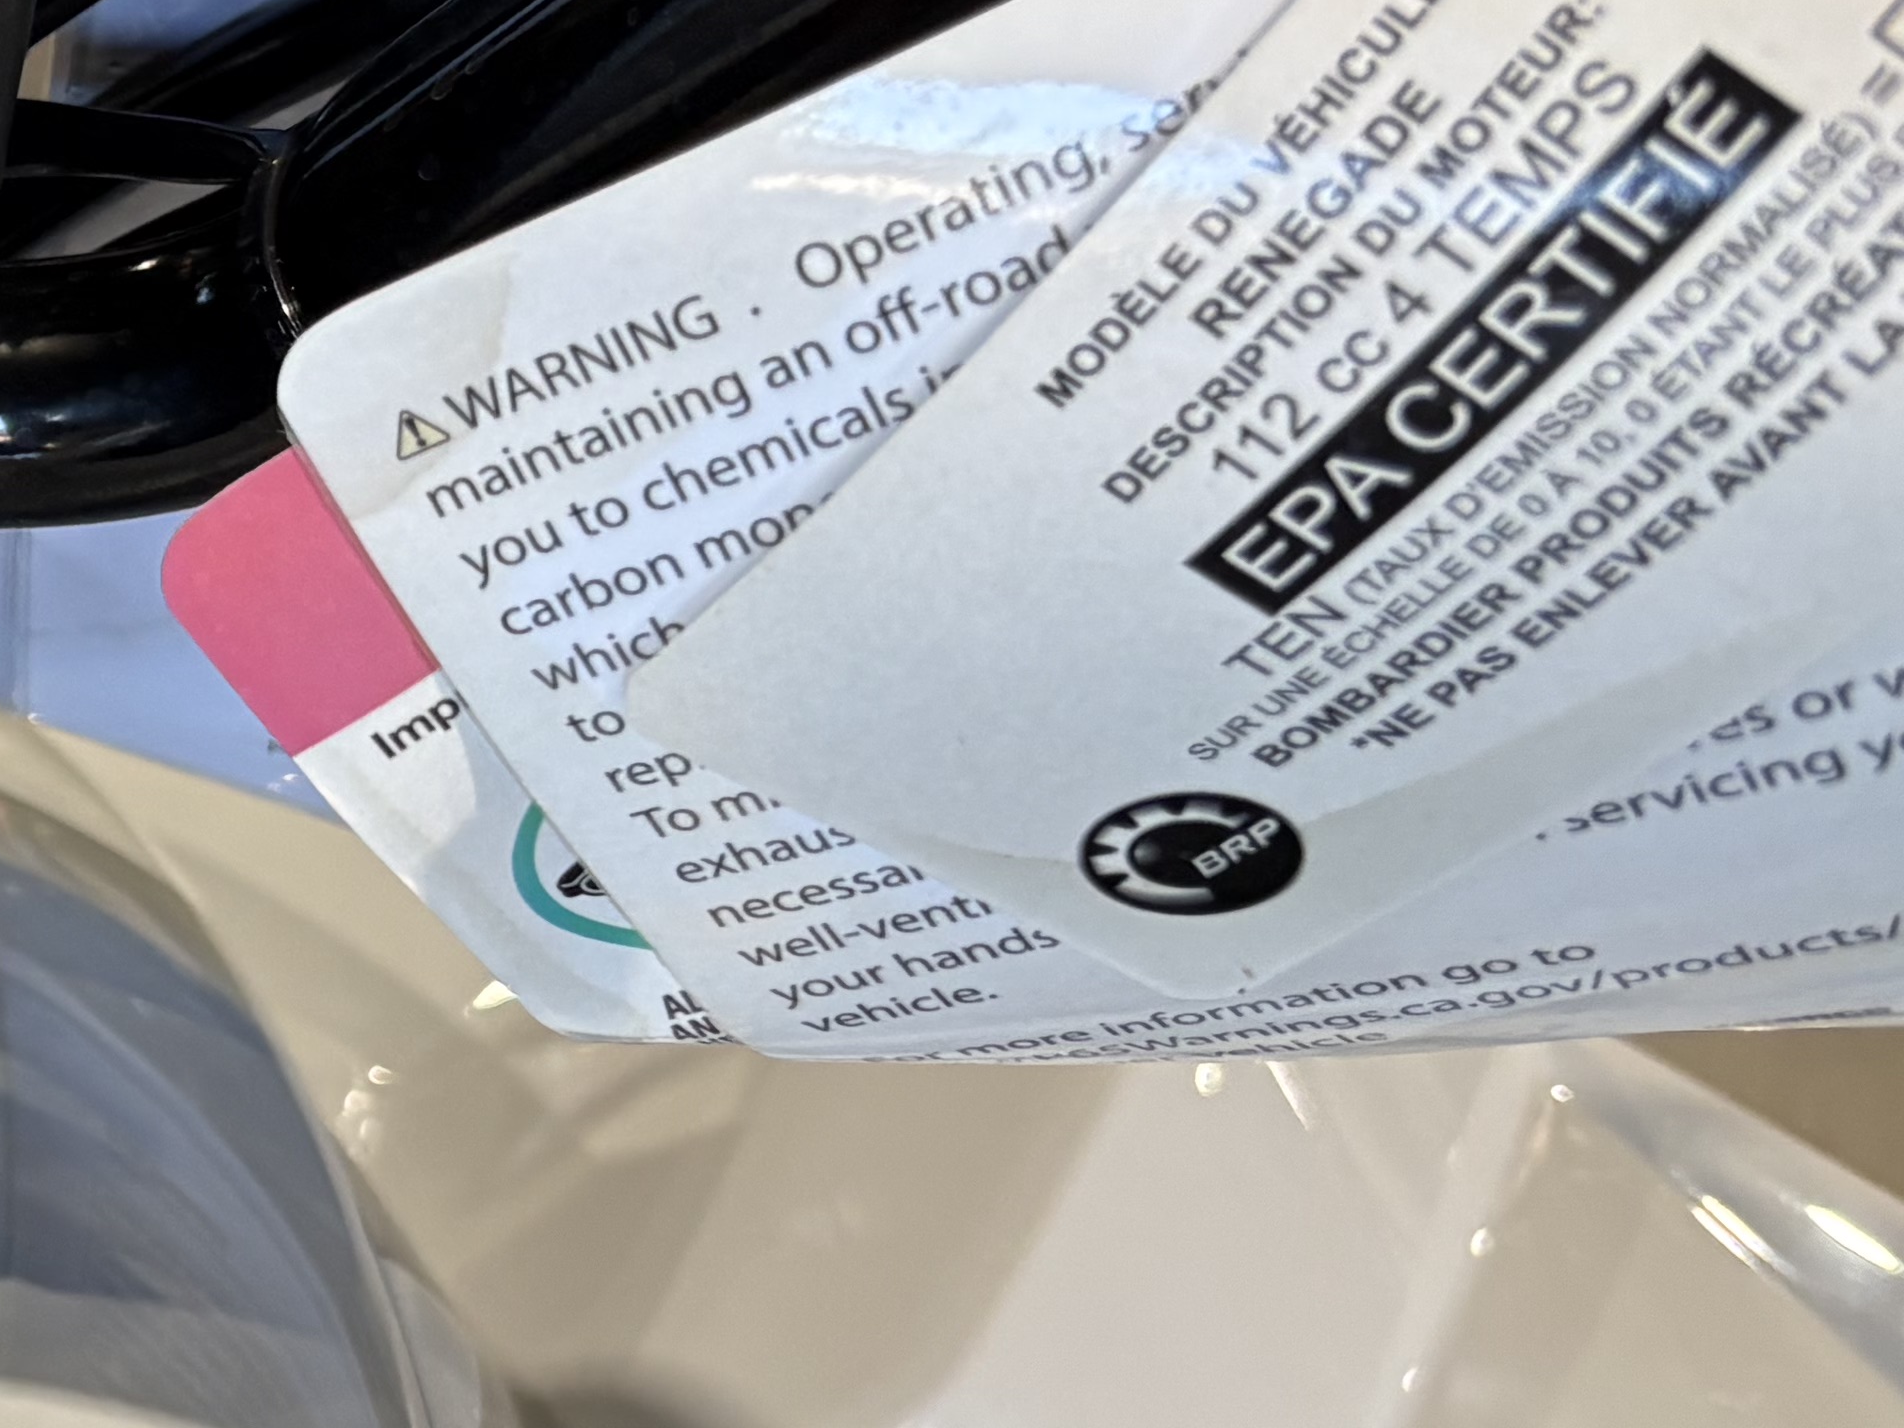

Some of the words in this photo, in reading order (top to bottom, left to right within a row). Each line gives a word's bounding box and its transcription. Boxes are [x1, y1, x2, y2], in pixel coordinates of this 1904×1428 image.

[444, 294, 720, 429] WARNING
[795, 138, 1111, 290] Operating,
[1034, 241, 1204, 410] MODÈLE
[1202, 178, 1263, 250] DU
[1189, 75, 1446, 341] RENEGADE
[1210, 389, 1321, 486] 112
[1316, 327, 1392, 397] CC
[1382, 274, 1436, 328] 4
[1410, 57, 1641, 276] TEMPS
[426, 363, 752, 518] maintaining
[760, 339, 832, 390] an
[845, 224, 1071, 356] off-road
[1099, 253, 1363, 504] DESCRIPTION
[1355, 188, 1423, 259] DU
[1221, 449, 1415, 593] EPA
[1384, 75, 1773, 454] CERTIFIÉ
[459, 518, 563, 588] you
[571, 493, 629, 537] to
[643, 386, 914, 514] chemicals
[1187, 709, 1256, 763] SUR
[1255, 660, 1333, 722] UNE
[1319, 542, 1475, 669] ÉCHELLE
[1467, 512, 1524, 566] DE
[1647, 286, 1769, 400] ÉTANT
[1760, 242, 1816, 300] LE
[1802, 154, 1901, 256] PLUS
[1425, 643, 1518, 711] PAS
[1508, 492, 1715, 653] ENLEVER
[1711, 372, 1850, 506] AVANT
[500, 552, 685, 637] carbon
[694, 491, 834, 569] mon
[1222, 591, 1346, 682] TEN
[1341, 502, 1454, 610] (TAUX
[1251, 581, 1521, 770] BOMBARDIER
[1506, 403, 1732, 588] PRODUITS
[370, 696, 462, 760] Imp
[567, 708, 626, 742] to
[605, 748, 692, 793] rep
[1791, 679, 1855, 721] or
[630, 806, 701, 840] To
[675, 826, 856, 884] exhaus
[1191, 818, 1281, 878] BRP
[770, 962, 883, 1010] your
[896, 925, 1061, 980] hands
[801, 989, 1000, 1033] vehicle.
[954, 1028, 1094, 1058] more
[1098, 974, 1427, 1038] information
[1441, 956, 1518, 984] go
[1530, 943, 1596, 964] to
